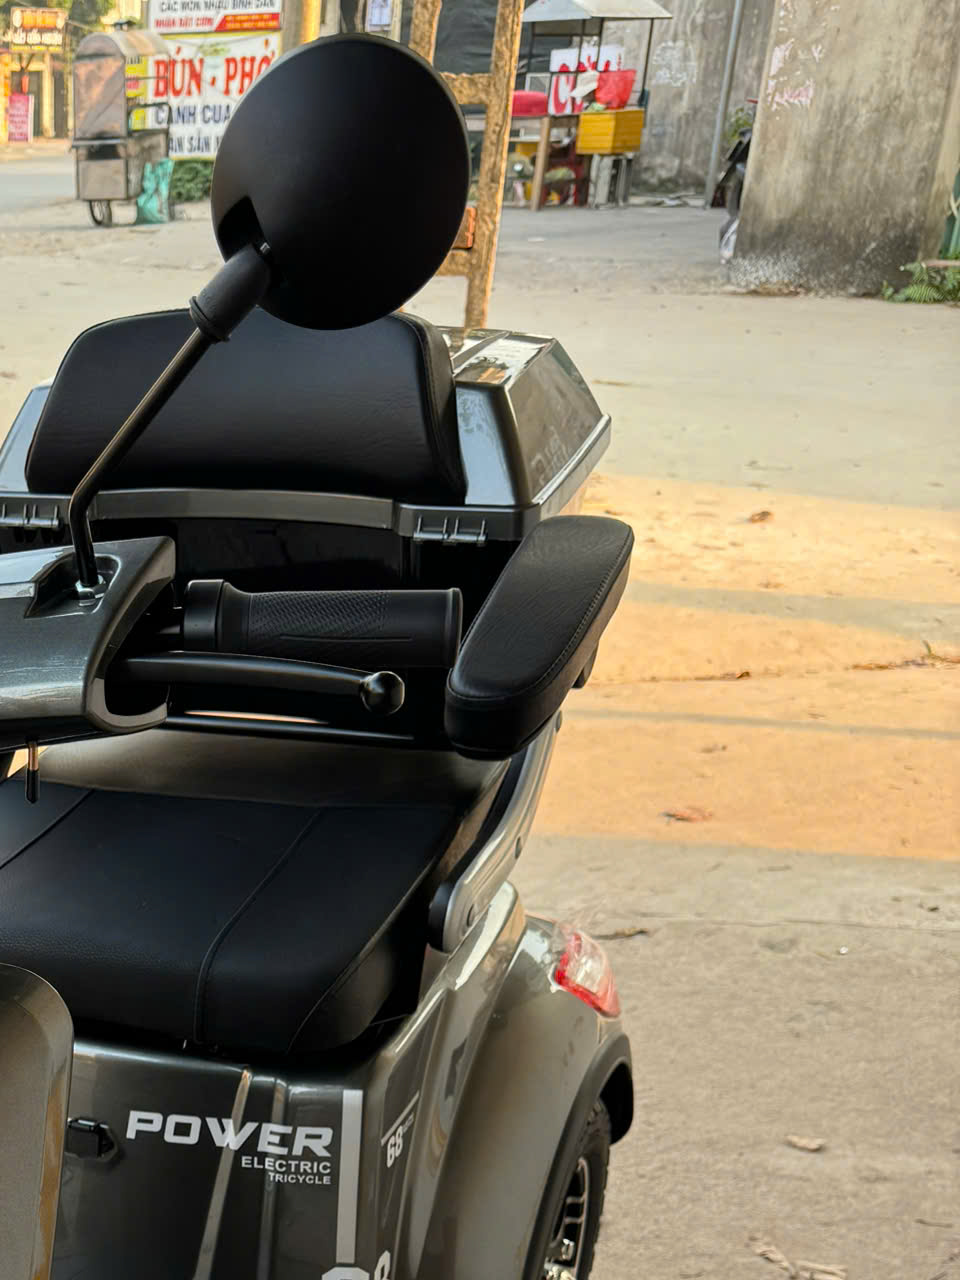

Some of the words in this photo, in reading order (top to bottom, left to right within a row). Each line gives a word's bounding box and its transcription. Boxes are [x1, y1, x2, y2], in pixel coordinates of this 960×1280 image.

[154, 46, 204, 98] BÚN
[126, 1110, 333, 1157] POWER
[386, 1125, 403, 1168] 68
[241, 1156, 331, 1174] ELECTRIC
[268, 1172, 331, 1185] TRICYCLE
